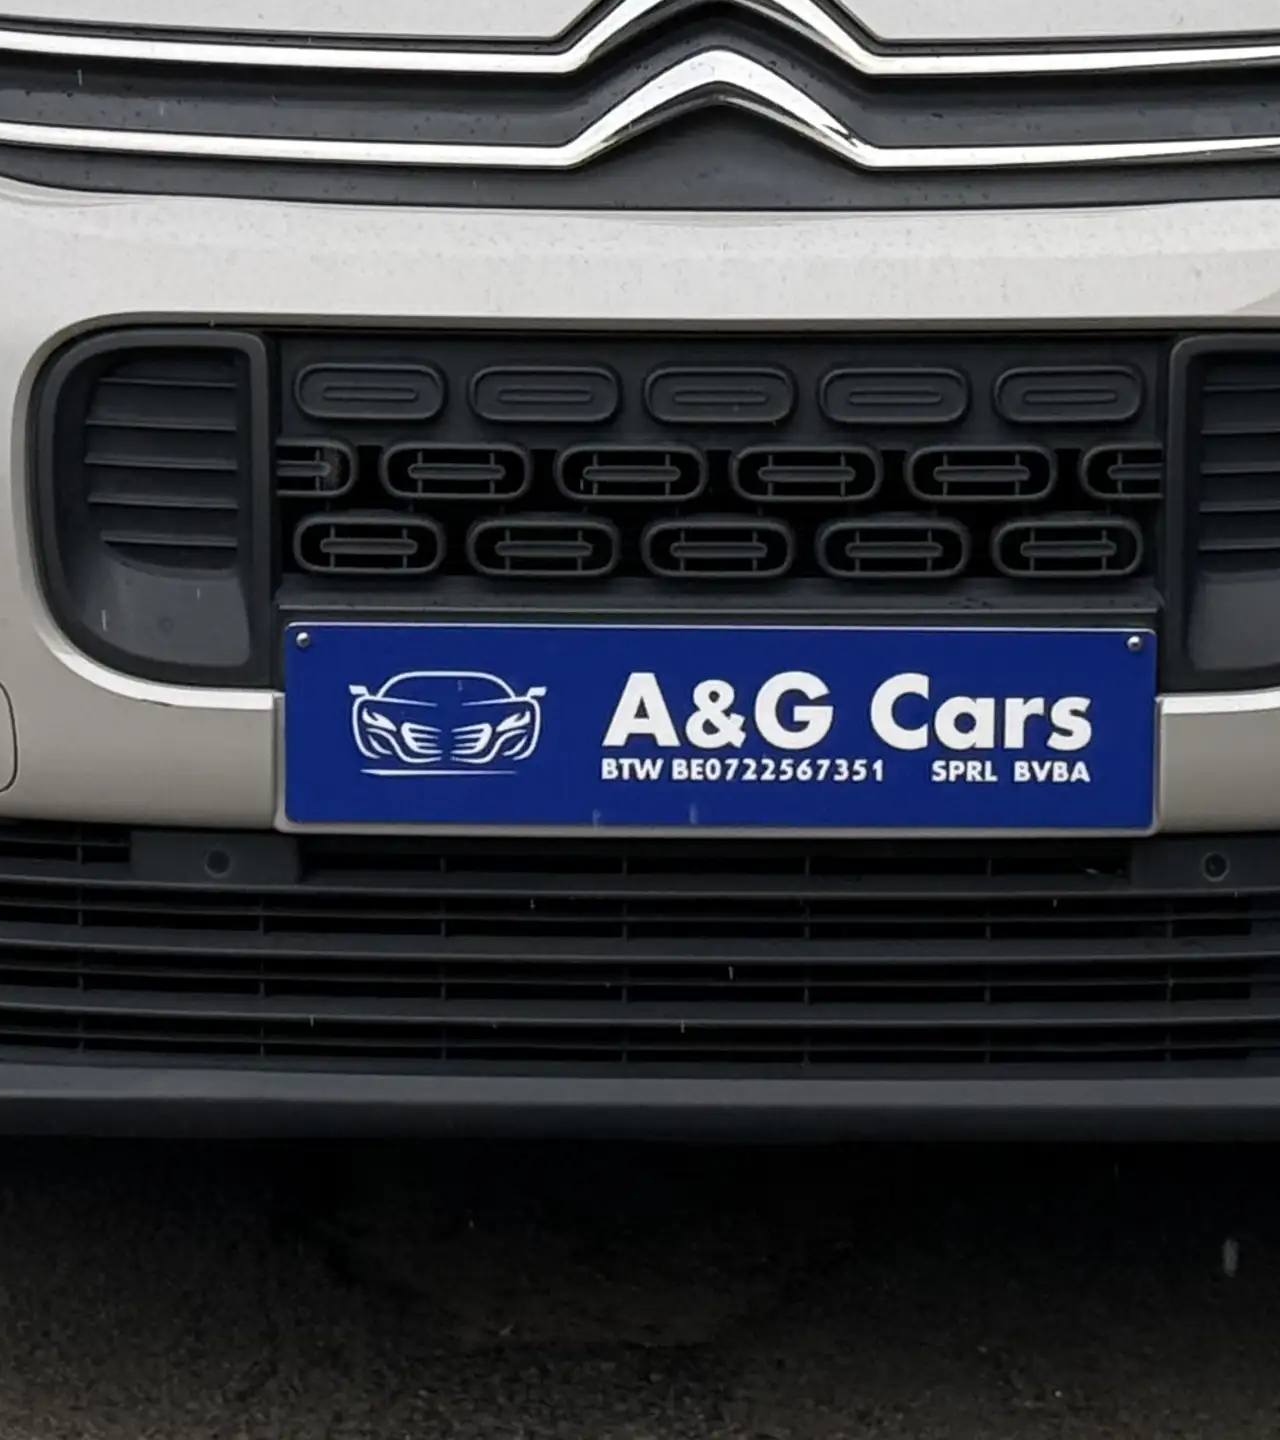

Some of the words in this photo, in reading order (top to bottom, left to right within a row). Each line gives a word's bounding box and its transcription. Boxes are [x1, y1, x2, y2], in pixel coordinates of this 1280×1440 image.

[602, 671, 834, 750] A&G
[870, 672, 1092, 751] Cars
[601, 758, 665, 780] BTW
[672, 758, 884, 782] BE0722567351
[931, 760, 998, 783] SPRL
[1013, 760, 1091, 783] BVBA
